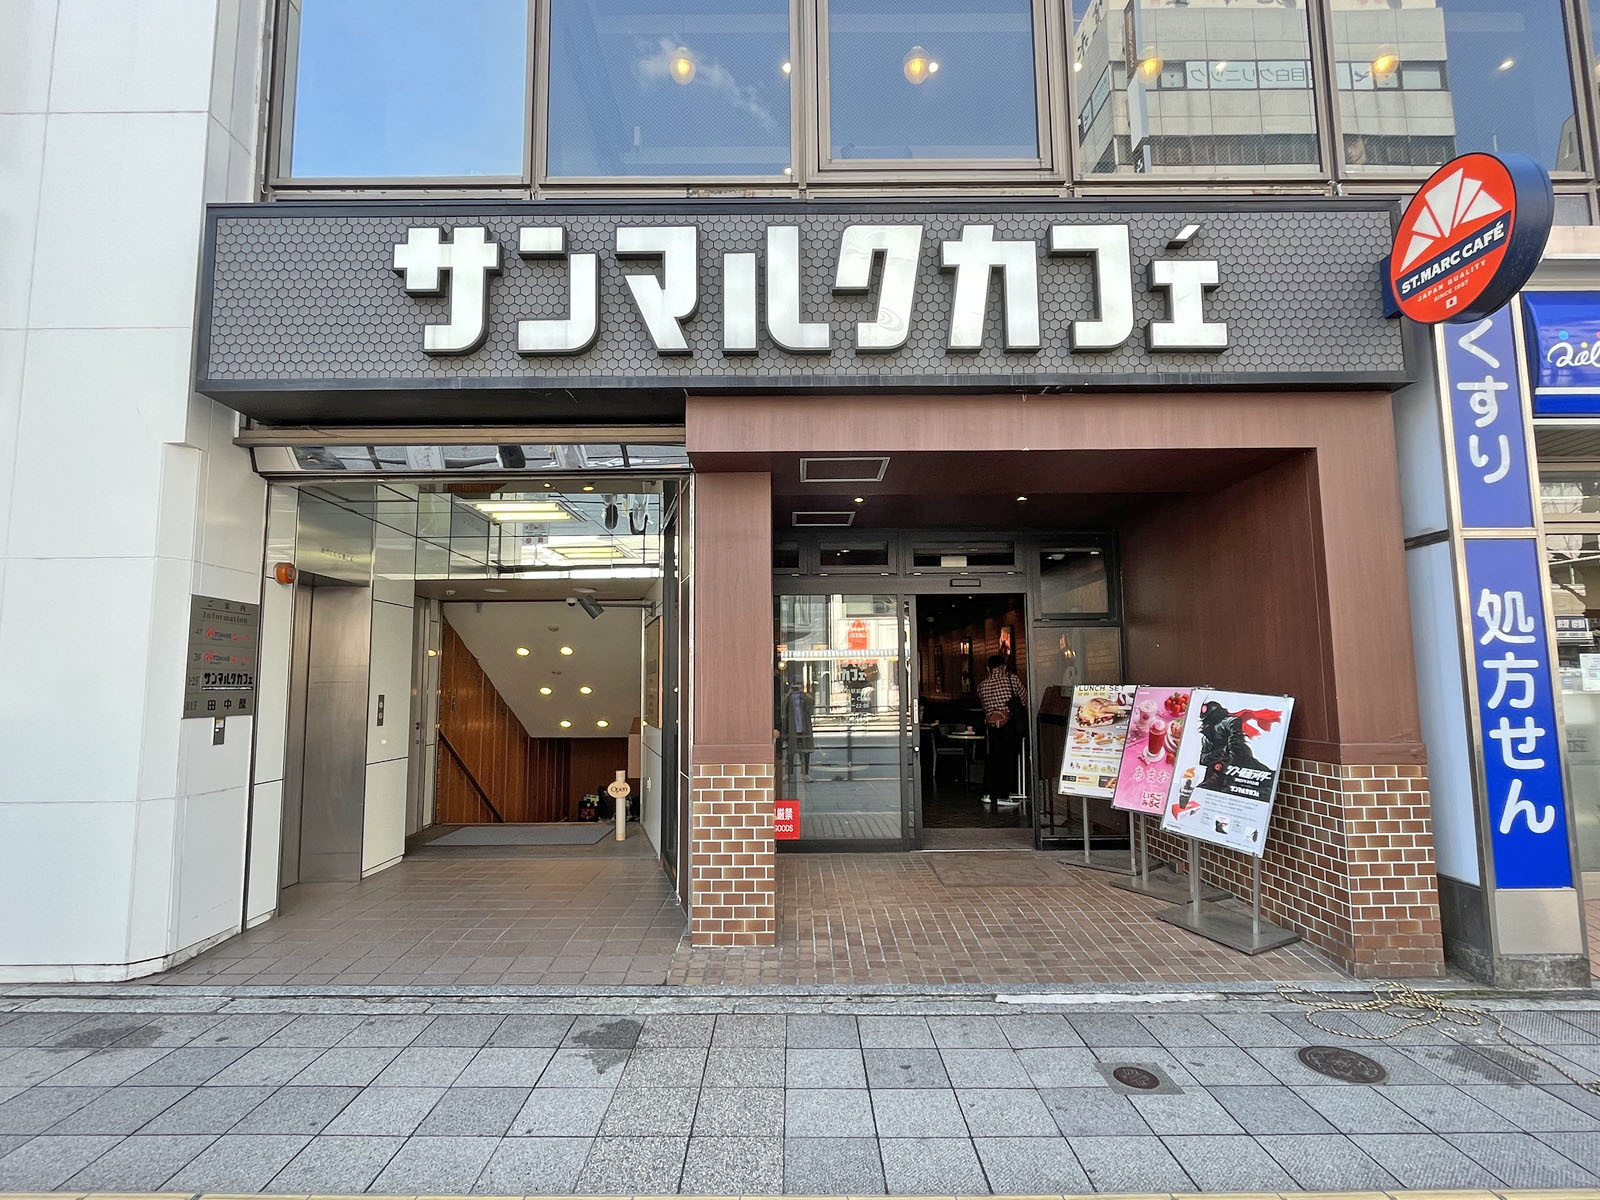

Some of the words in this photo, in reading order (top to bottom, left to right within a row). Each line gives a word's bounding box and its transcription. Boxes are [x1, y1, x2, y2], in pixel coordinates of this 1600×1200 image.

[1400, 248, 1462, 296] ST.MARC
[1461, 220, 1506, 258] CAFÉ
[393, 224, 1229, 353] サンマルクカフェ
[1417, 283, 1444, 303] JAPAN
[1447, 259, 1487, 286] QUALITY
[1456, 318, 1512, 485] くすり
[203, 611, 248, 624] Information
[204, 672, 253, 685] サンマルクカフェ
[207, 698, 246, 711] 田中屋
[1477, 588, 1556, 835] 処方せん
[610, 785, 628, 794] Open
